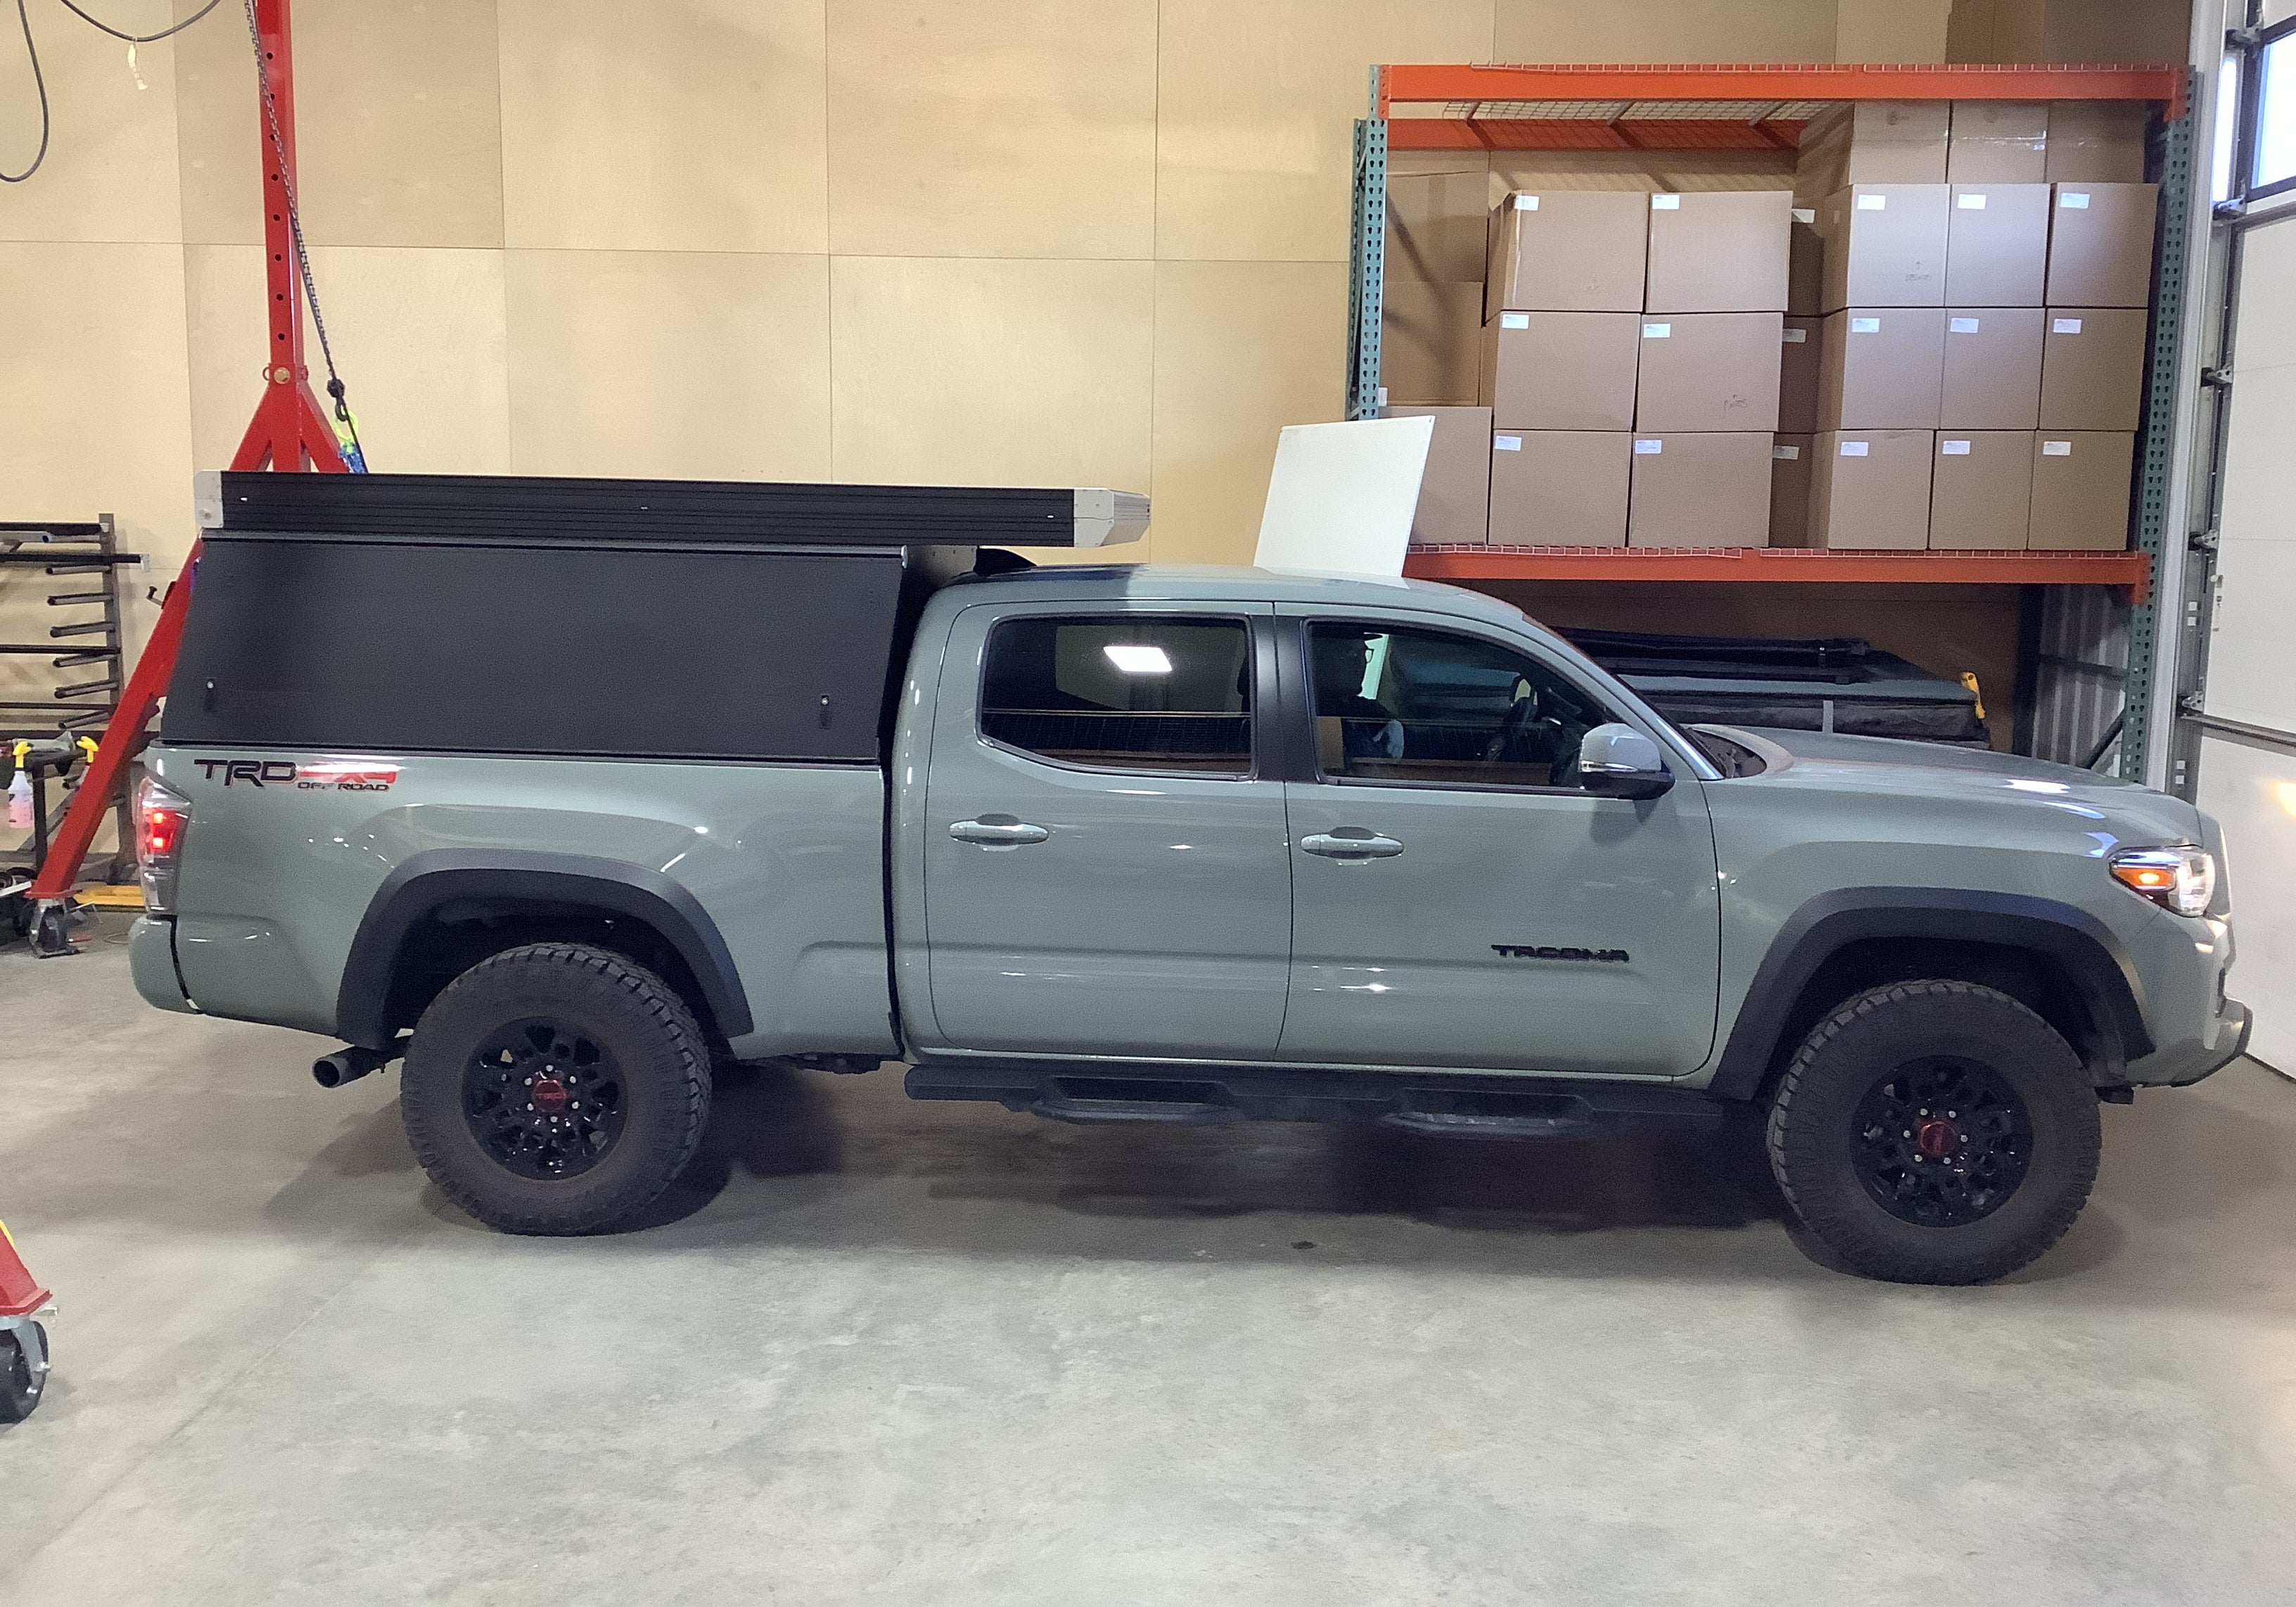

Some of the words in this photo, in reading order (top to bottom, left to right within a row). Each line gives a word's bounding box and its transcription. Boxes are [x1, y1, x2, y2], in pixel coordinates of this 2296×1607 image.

[194, 758, 298, 787] TRD
[298, 782, 334, 790] OFF
[338, 782, 390, 792] ROAD
